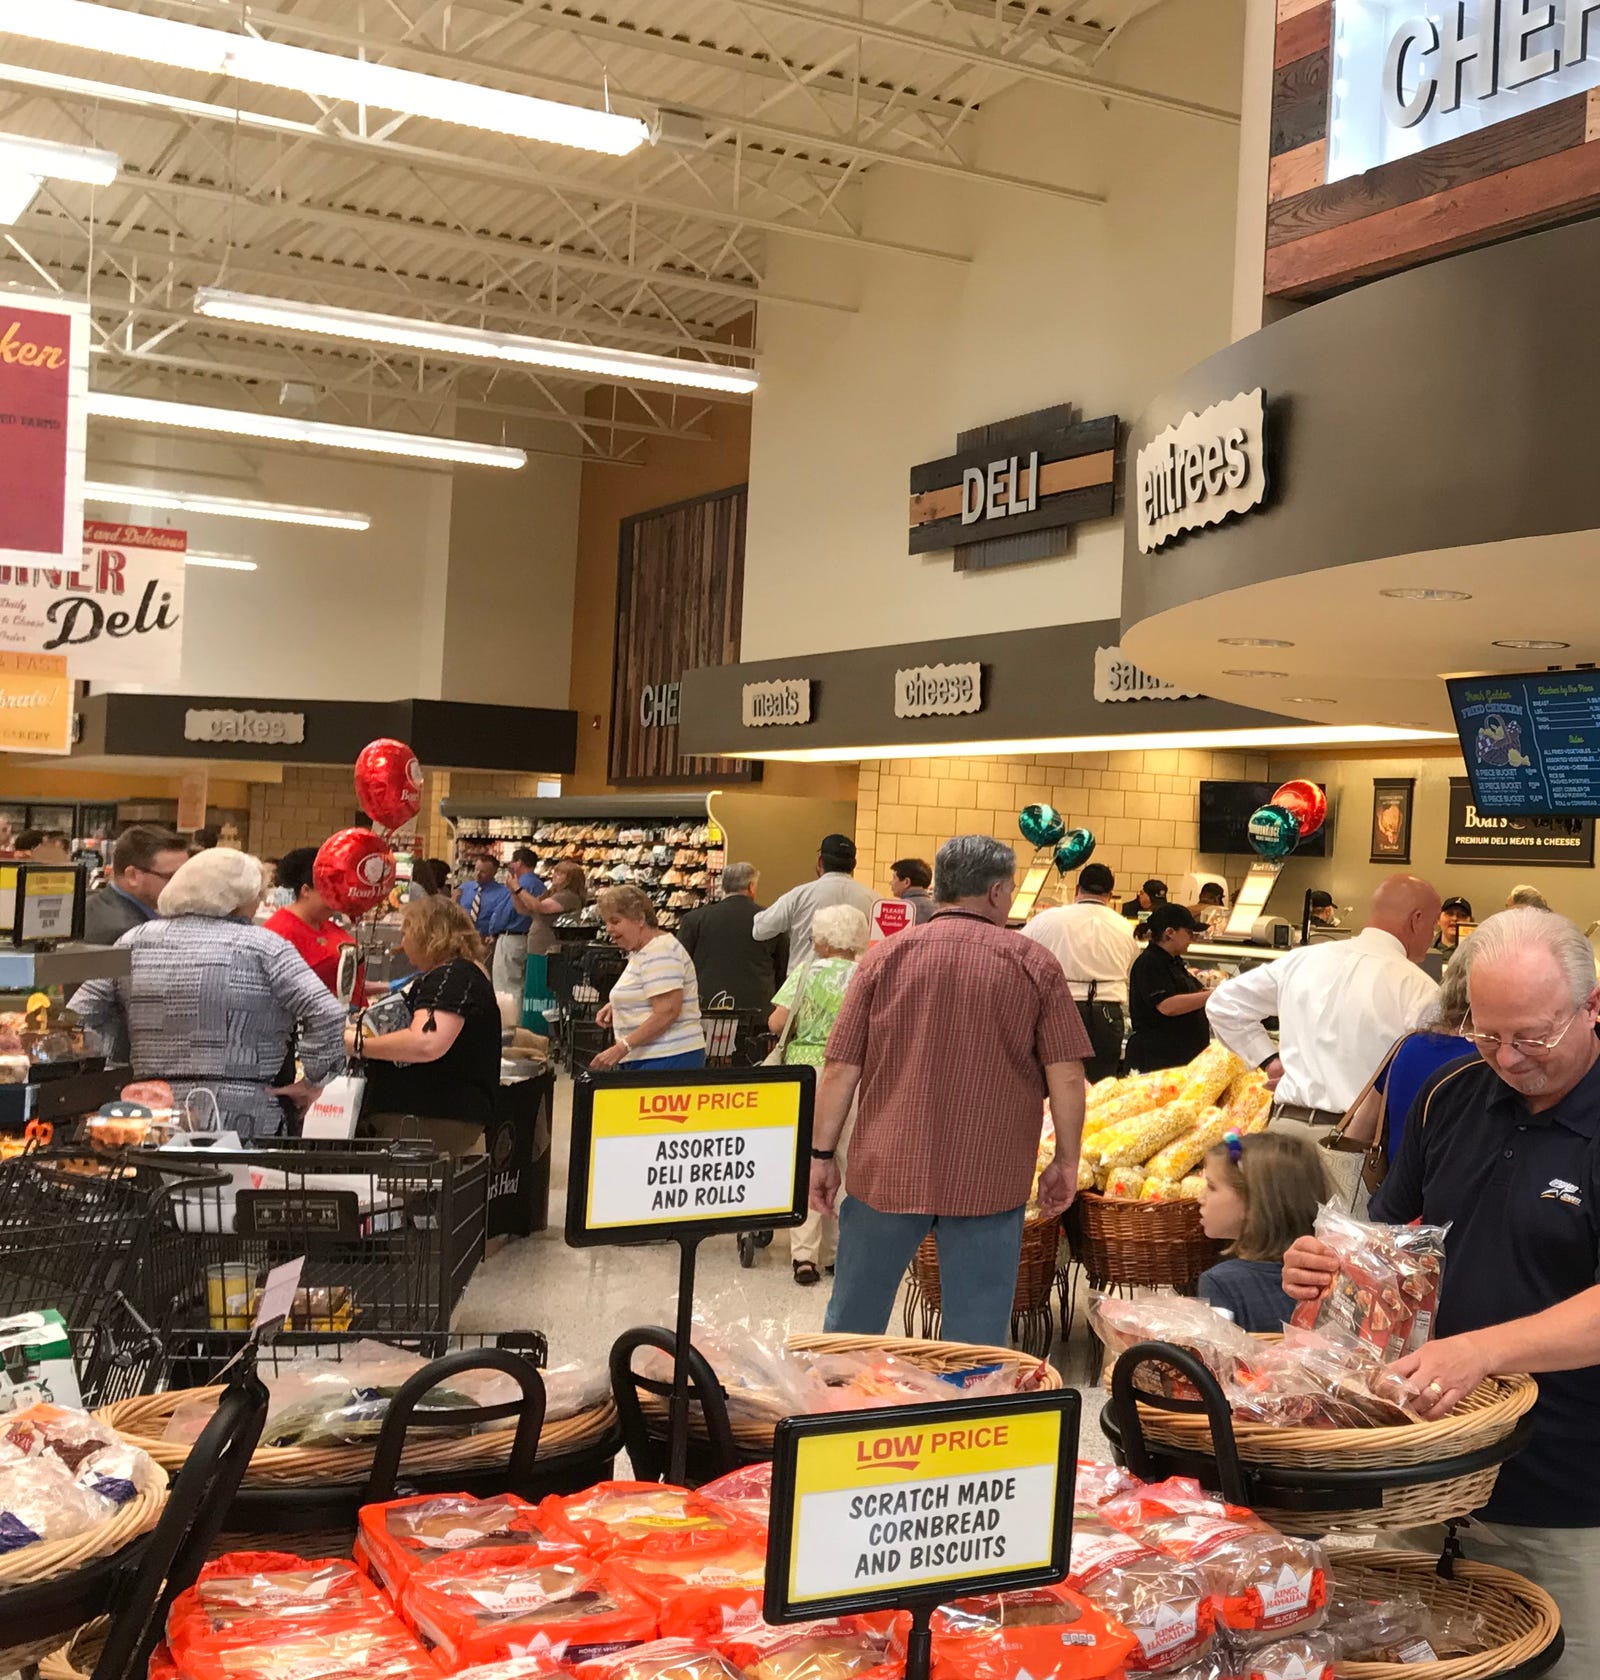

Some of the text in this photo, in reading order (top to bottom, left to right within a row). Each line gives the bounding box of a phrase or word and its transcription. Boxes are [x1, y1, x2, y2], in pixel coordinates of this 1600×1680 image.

[960, 451, 1039, 525] DELI
[1138, 426, 1248, 526] entrees
[43, 579, 180, 650] Deli
[903, 671, 974, 706] cheese
[752, 687, 799, 720] meats
[210, 714, 286, 738] cakes
[1455, 836, 1580, 846] PREMIUM DELI MEATS CHEESES
[639, 1092, 759, 1114] LOW PRICE
[656, 1137, 745, 1161] ASSORTED
[647, 1160, 755, 1186] DELI BREADS
[652, 1185, 746, 1211] AND ROLLS
[857, 1425, 1008, 1462] LOW PRICE
[849, 1477, 1016, 1520] SCRATCH MADE
[869, 1508, 1000, 1546] CORNBREAD
[855, 1535, 1006, 1578] AND BISCUITS
[1265, 1592, 1307, 1610] HAWAIIAN
[1274, 1611, 1298, 1624] SLICED
[1146, 1624, 1194, 1650] HAWAIIAN
[1159, 1643, 1186, 1661] SLICED
